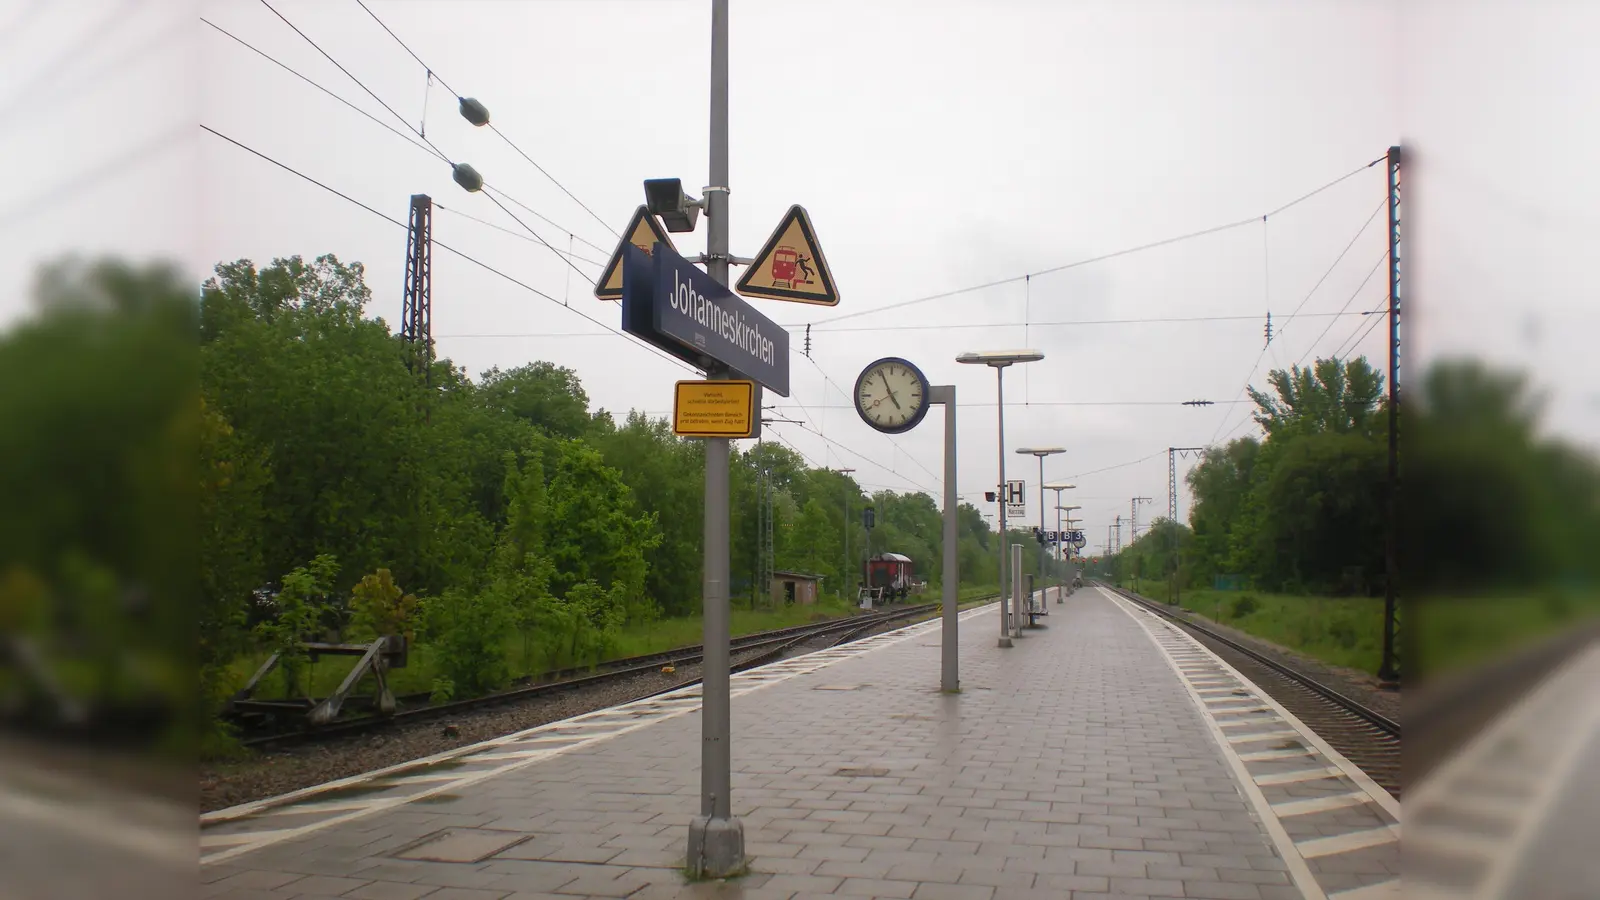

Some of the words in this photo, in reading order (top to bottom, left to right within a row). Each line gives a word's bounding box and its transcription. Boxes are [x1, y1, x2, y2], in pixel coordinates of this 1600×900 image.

[670, 269, 774, 366] Johanneskirchen
[1009, 482, 1023, 503] H
[1048, 531, 1054, 539] B
[1064, 531, 1070, 539] B
[1076, 531, 1081, 539] 3
